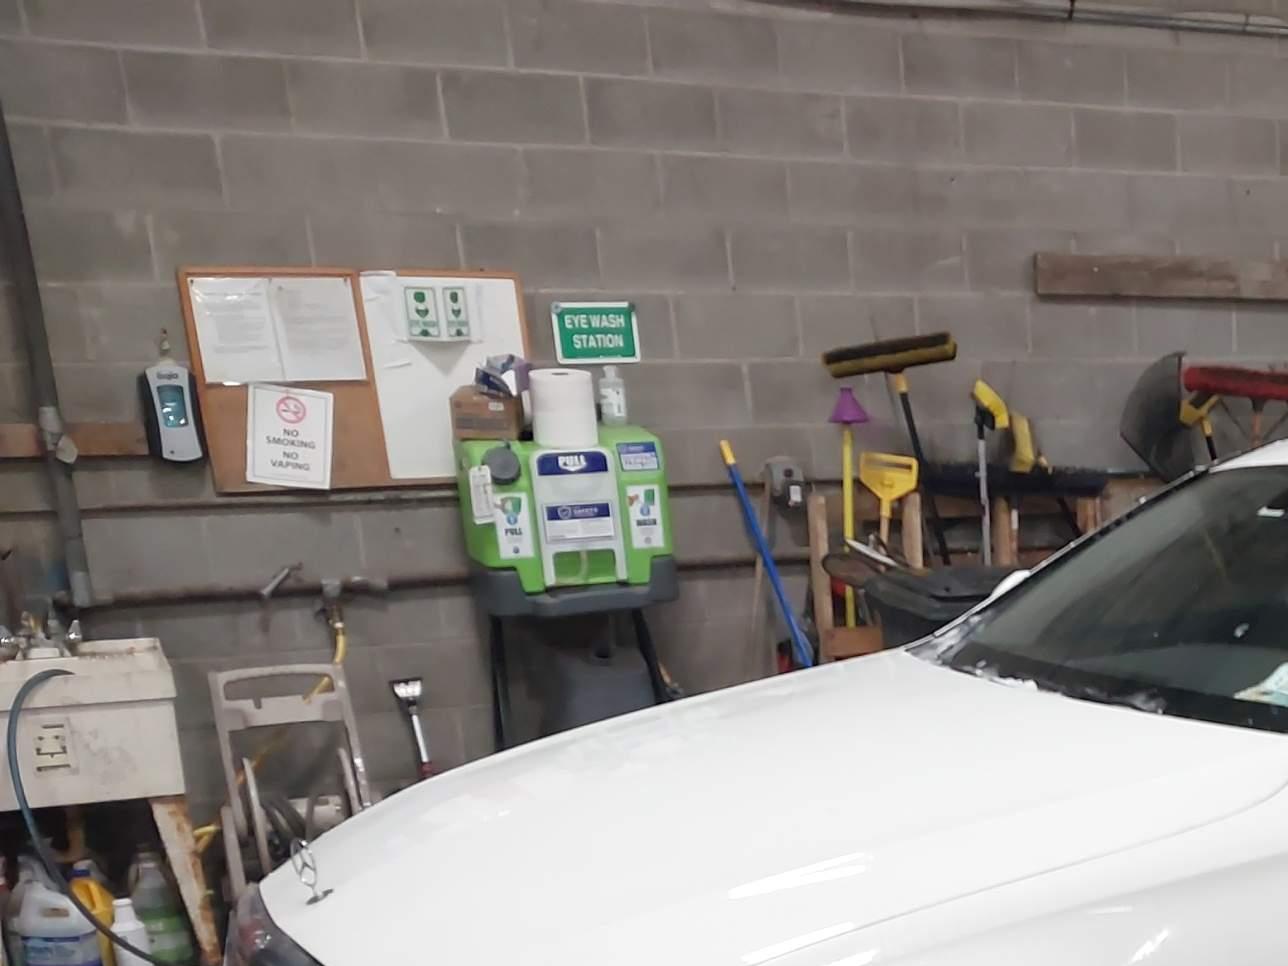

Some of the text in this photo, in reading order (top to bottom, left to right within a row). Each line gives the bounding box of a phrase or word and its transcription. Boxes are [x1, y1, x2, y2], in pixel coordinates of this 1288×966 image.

[564, 314, 625, 329] EYE WASH
[572, 333, 624, 349] STATION
[282, 428, 300, 438] NO
[265, 436, 316, 450] SMOKING
[282, 451, 299, 460] NO
[557, 454, 586, 467] PULL
[270, 459, 311, 472] VAPING
